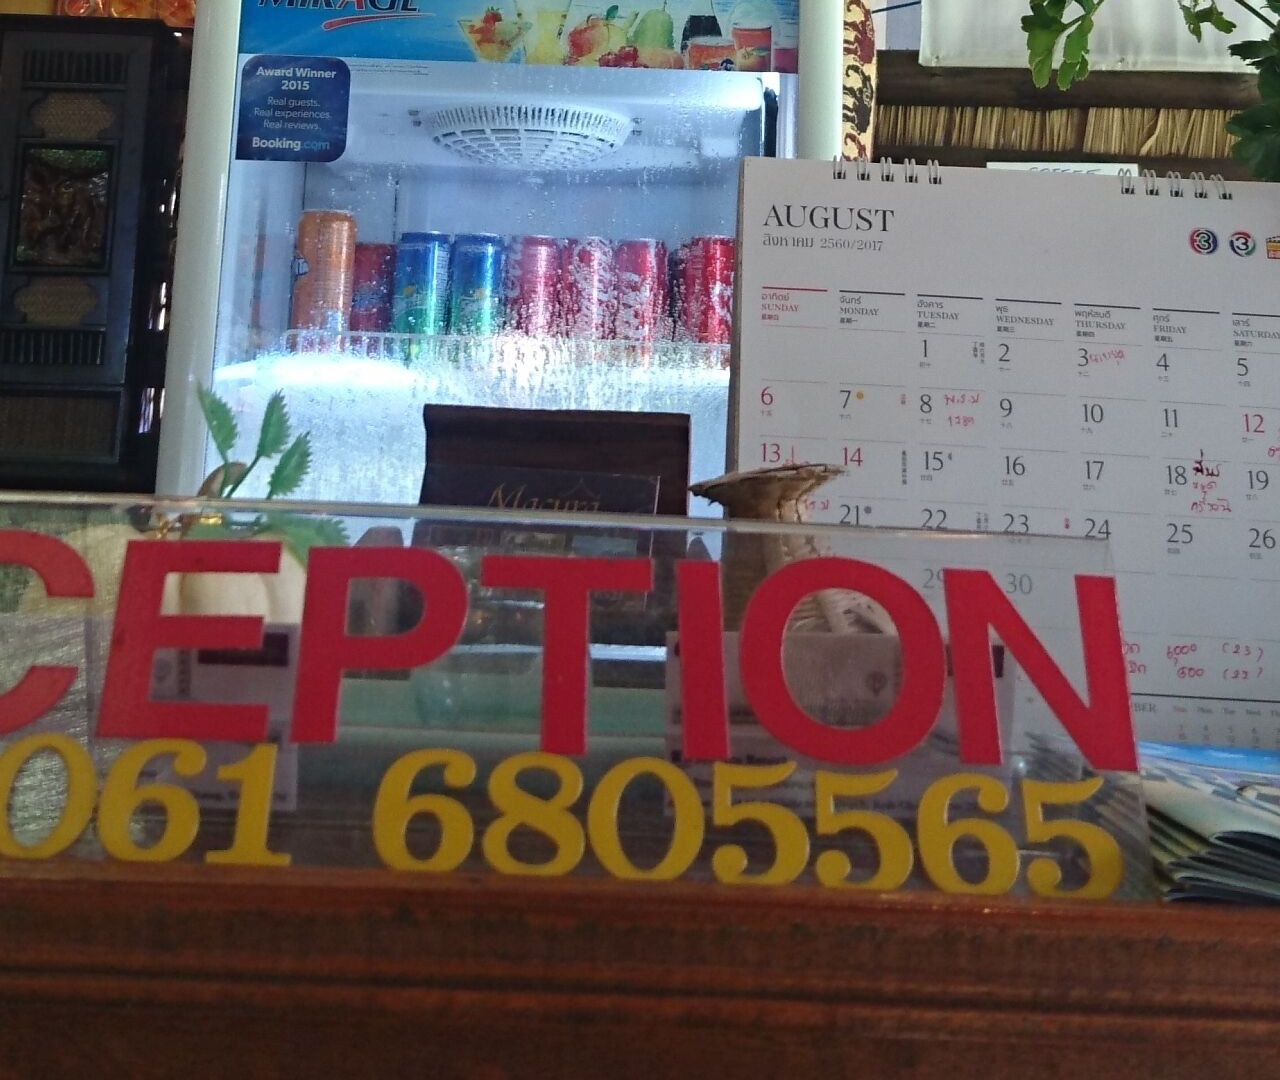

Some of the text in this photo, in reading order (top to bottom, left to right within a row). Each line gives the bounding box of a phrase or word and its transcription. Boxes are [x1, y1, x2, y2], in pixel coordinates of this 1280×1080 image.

[256, 66, 294, 78] Award
[295, 67, 337, 80] Winner
[281, 80, 310, 91] 2015
[267, 96, 321, 108] Real guests.
[254, 108, 333, 120] Real experiences.
[263, 120, 322, 130] Real reviews.
[252, 137, 331, 152] Booking.com
[763, 203, 895, 233] AUGUST
[762, 234, 884, 252] สิงหาคม 2560/2017
[839, 295, 862, 306] จันทร์
[761, 302, 800, 313] SUNDAY
[839, 306, 880, 316] MONDAY
[917, 310, 960, 321] TUESDAY
[995, 314, 1055, 327] WEDNESDAY
[1075, 320, 1126, 331] THURSDAY
[1152, 324, 1187, 334] FRIDAY
[921, 339, 929, 358] 1
[998, 343, 1011, 362] 2
[1077, 348, 1089, 367] 3
[1156, 353, 1170, 371] 4
[1237, 358, 1249, 377] 5
[760, 386, 1265, 433] 6 7 8 9 10 11 12
[760, 443, 1269, 490] 13 14 15 16 17 18 19
[839, 504, 1276, 549] 21 22 23 24 25 26
[1006, 573, 1033, 595] 30
[372, 750, 1133, 900] 6805565
